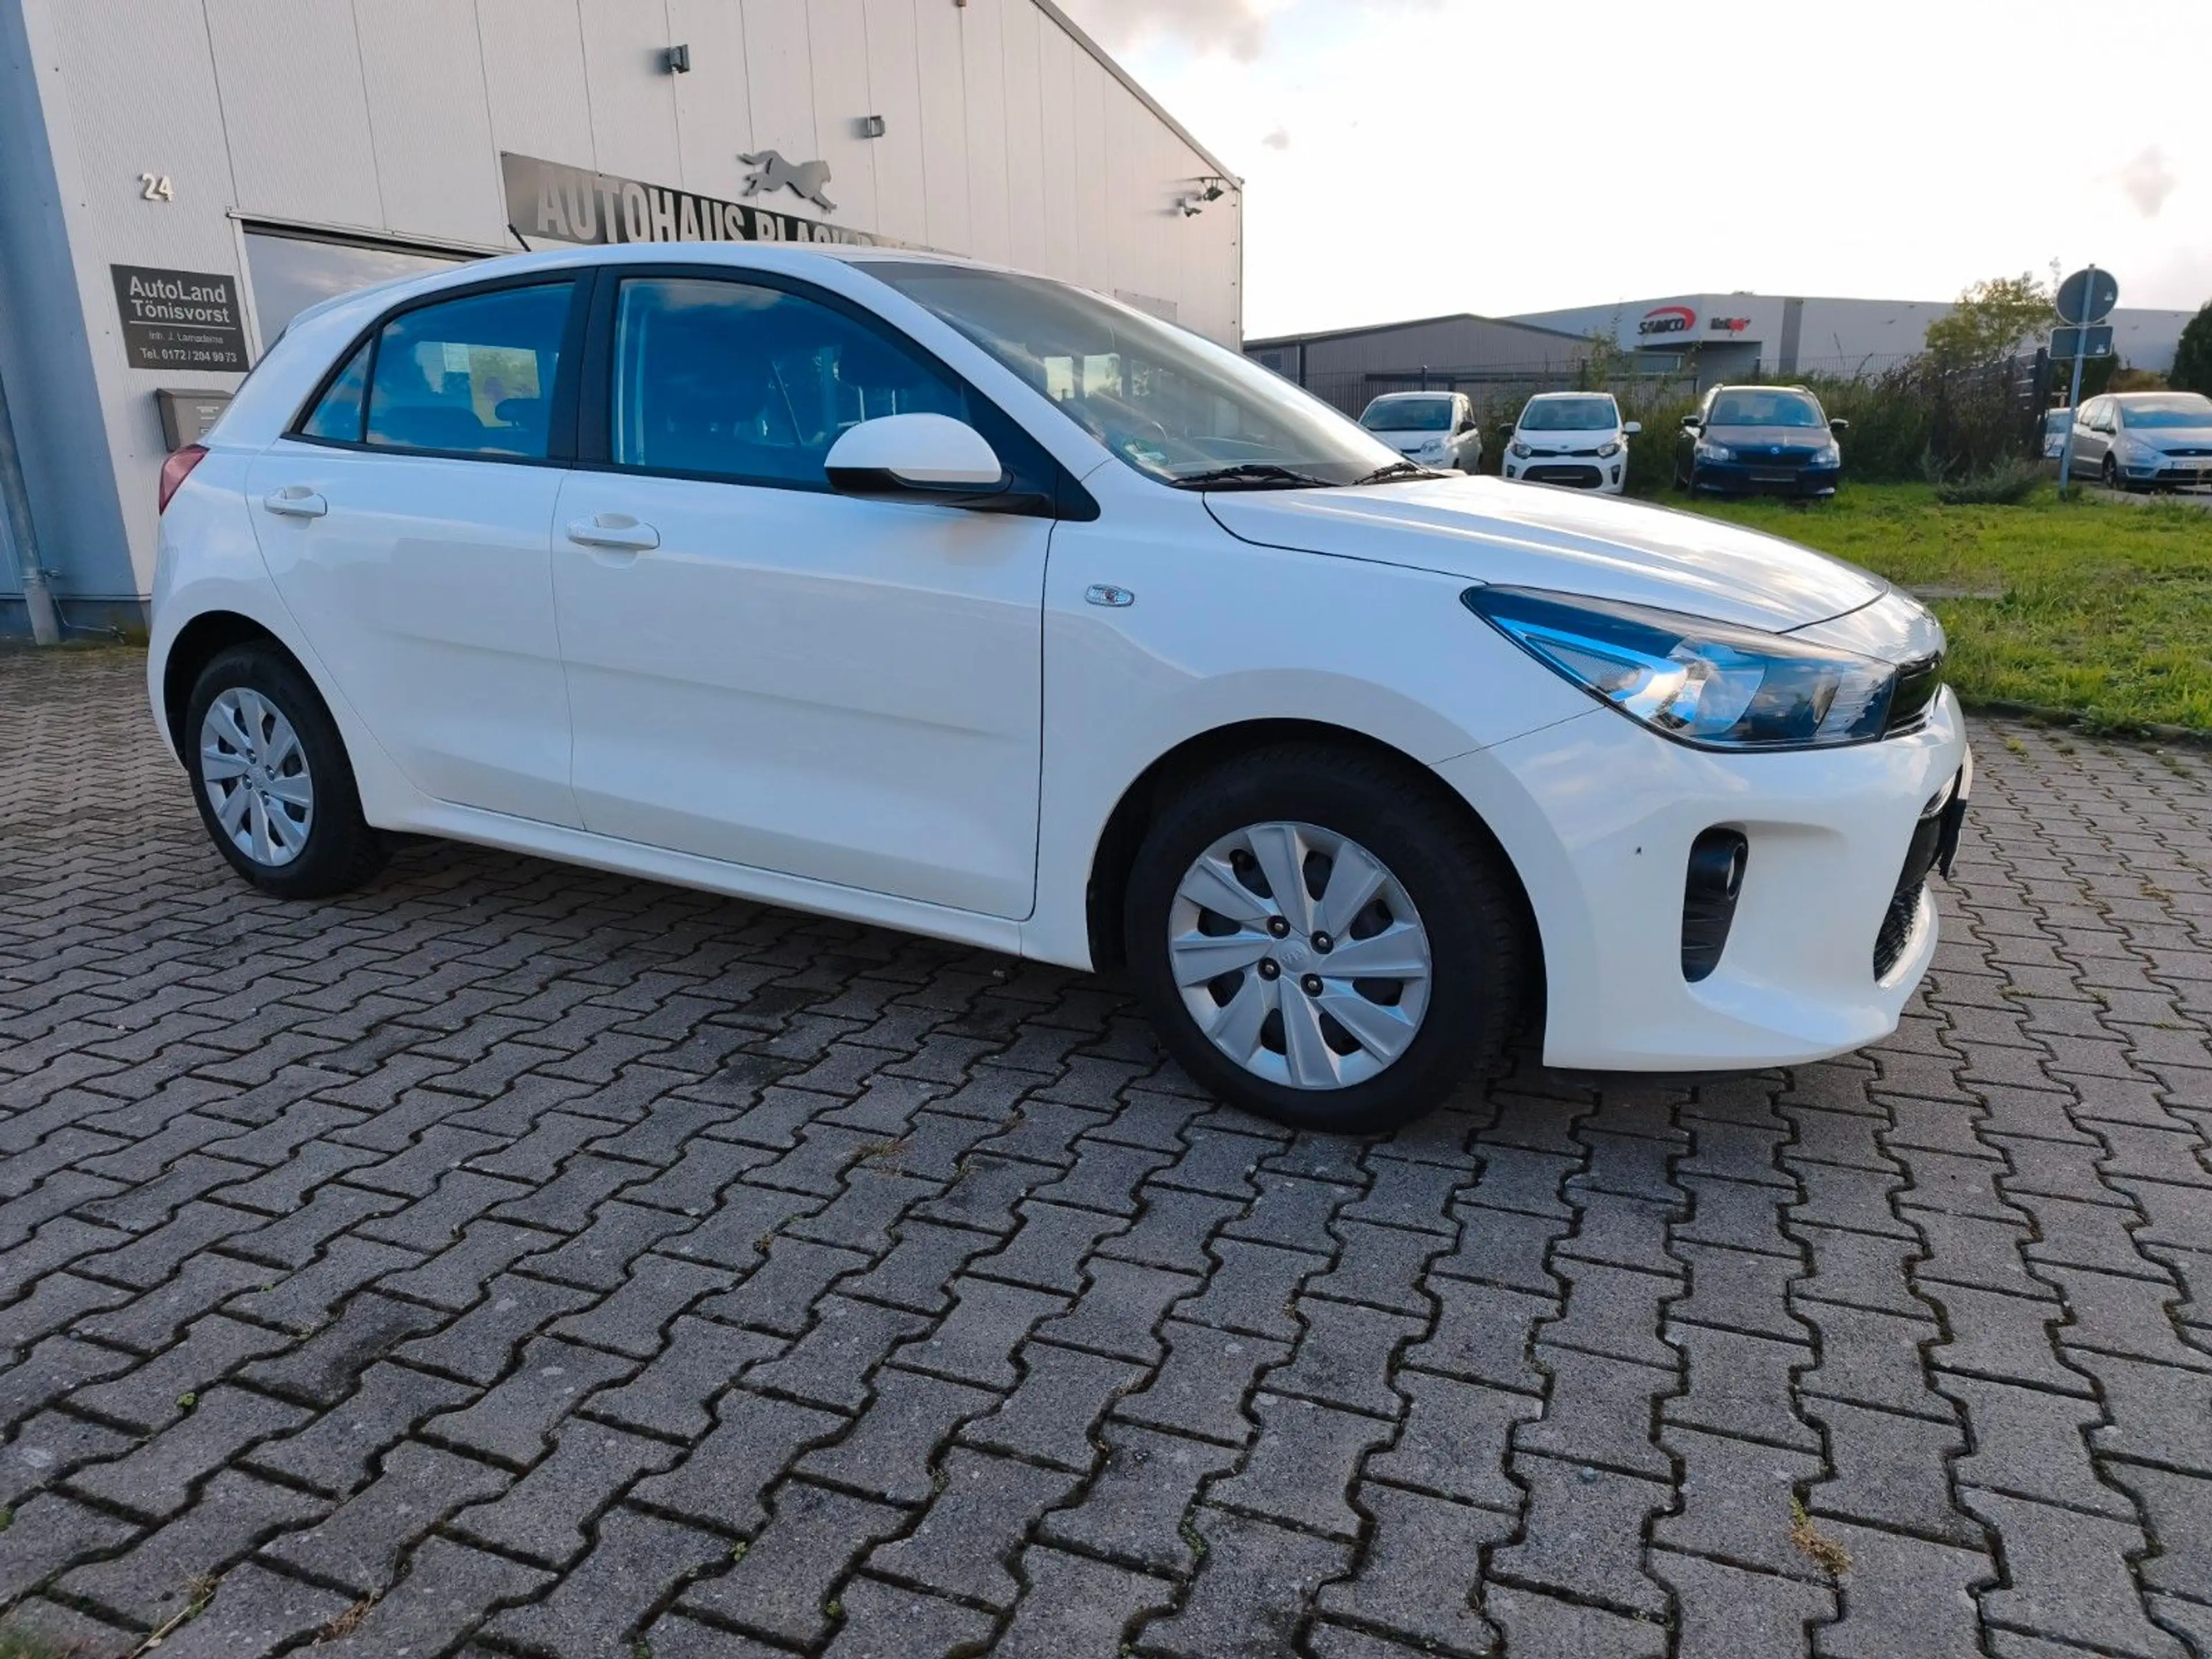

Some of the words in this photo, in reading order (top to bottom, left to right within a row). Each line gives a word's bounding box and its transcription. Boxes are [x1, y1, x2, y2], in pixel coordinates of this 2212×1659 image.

[142, 174, 175, 201] 24
[537, 165, 745, 244] AUTOHAUS
[130, 275, 227, 304] AutoLand
[131, 298, 230, 323] Tönisvorst
[140, 347, 160, 360] Tel.
